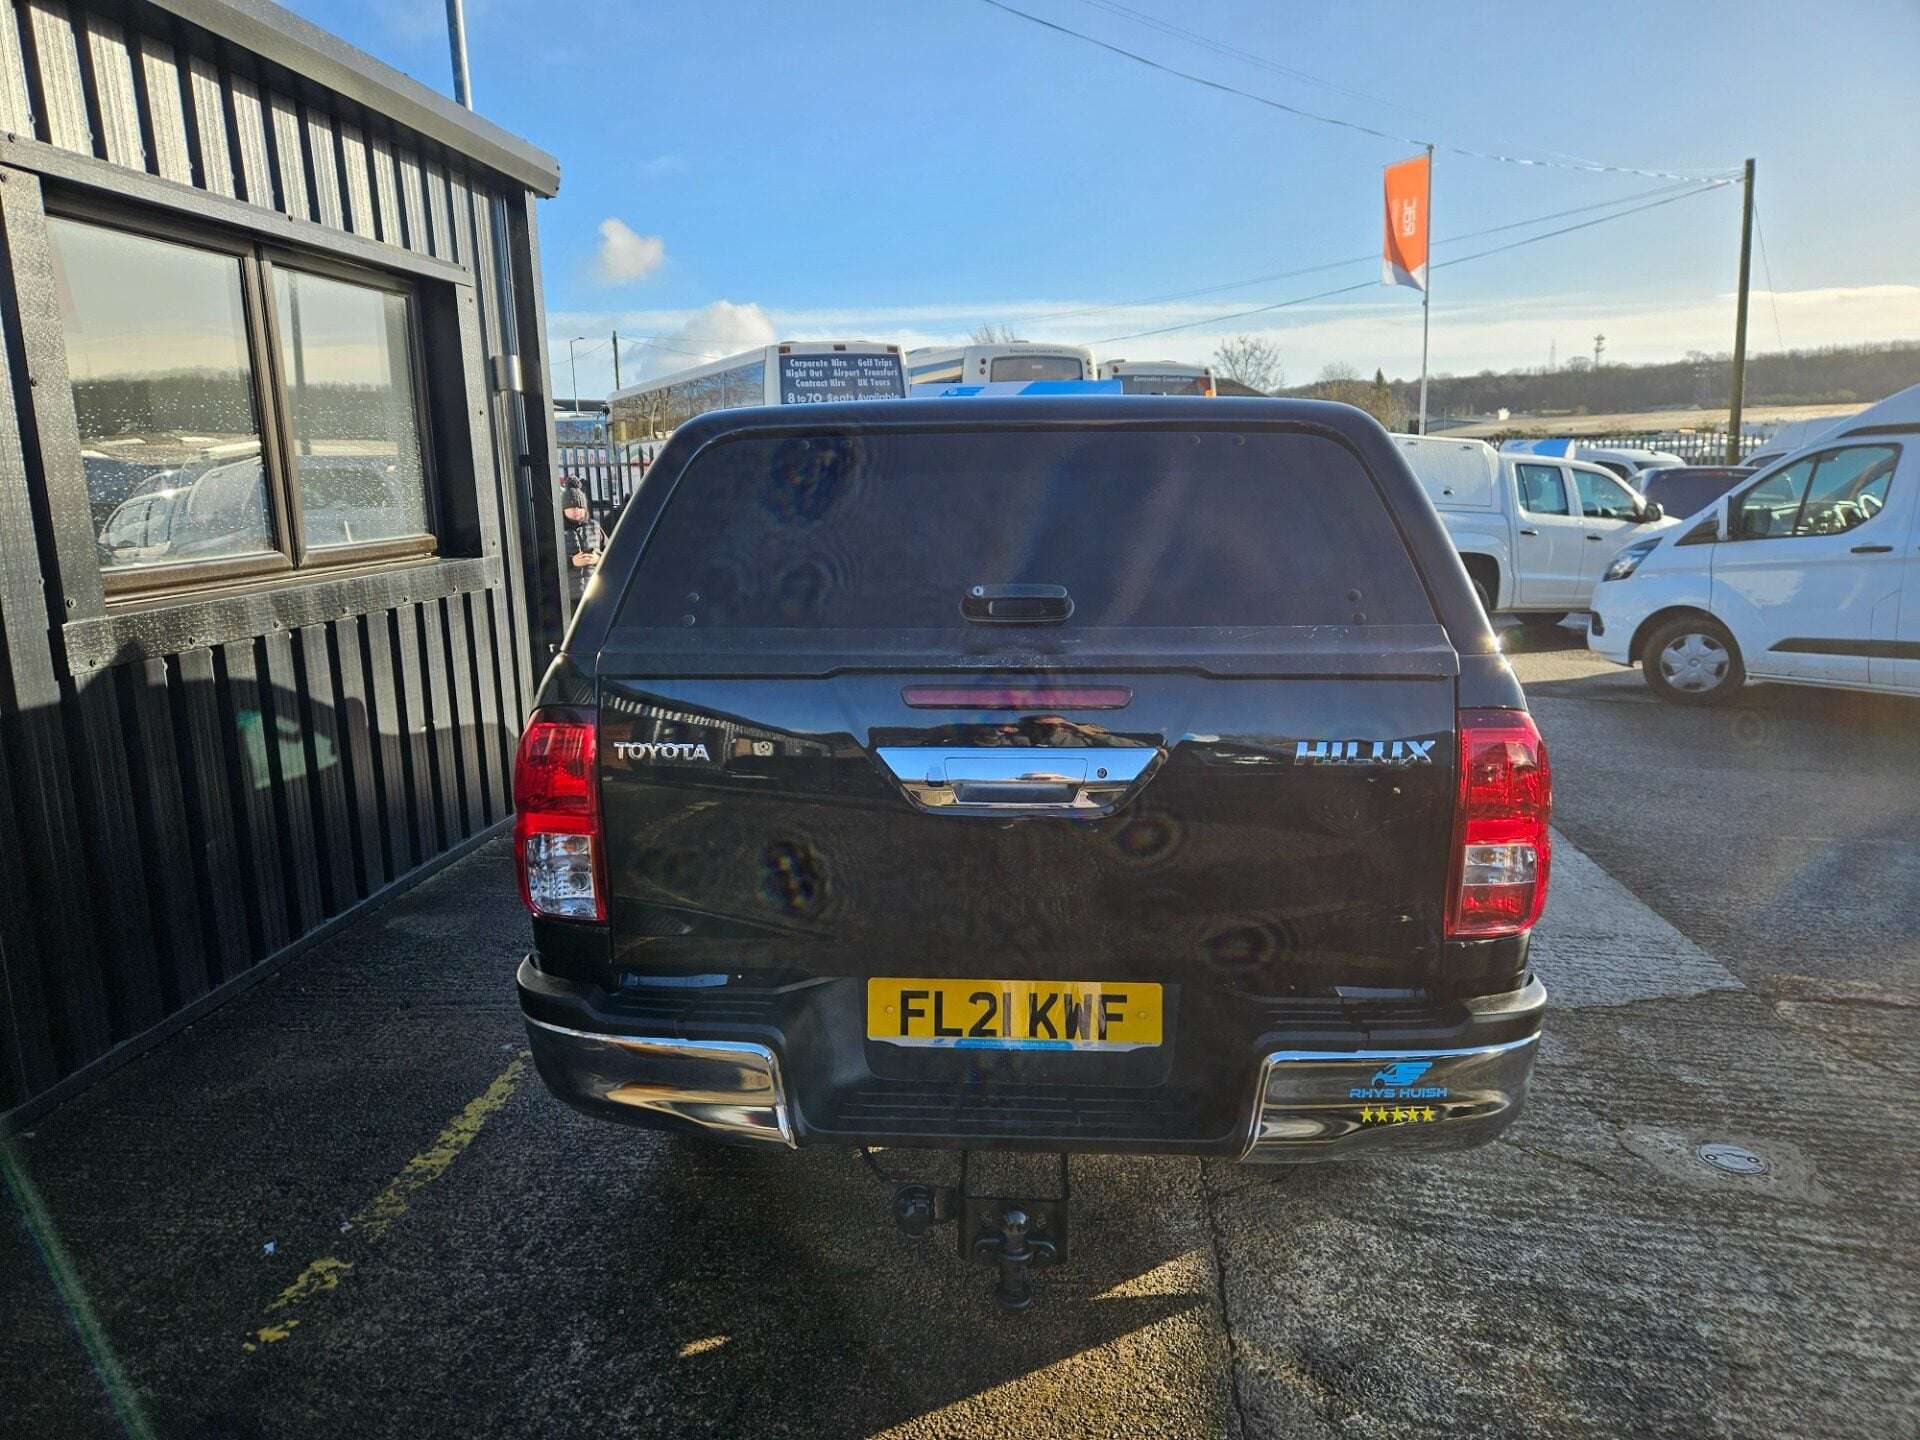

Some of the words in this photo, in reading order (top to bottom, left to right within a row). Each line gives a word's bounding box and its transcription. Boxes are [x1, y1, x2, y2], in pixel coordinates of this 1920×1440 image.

[790, 359, 828, 368] Corporate
[831, 359, 847, 367] Hire
[857, 359, 873, 367] Golf
[873, 358, 892, 368] Trips
[786, 369, 806, 378] Night
[809, 369, 822, 377] Out
[833, 368, 859, 378] Airport
[796, 379, 828, 387] Contract
[830, 379, 846, 387] Hire
[788, 392, 795, 403] 8
[797, 394, 806, 403] to
[807, 393, 822, 403] 70
[613, 742, 710, 761] TOYOTA
[1295, 740, 1436, 766] HILUX
[900, 990, 1012, 1038] FL21
[1028, 992, 1128, 1041] KWF
[1348, 1087, 1396, 1098] RHYS
[1399, 1087, 1448, 1098] HUISH
